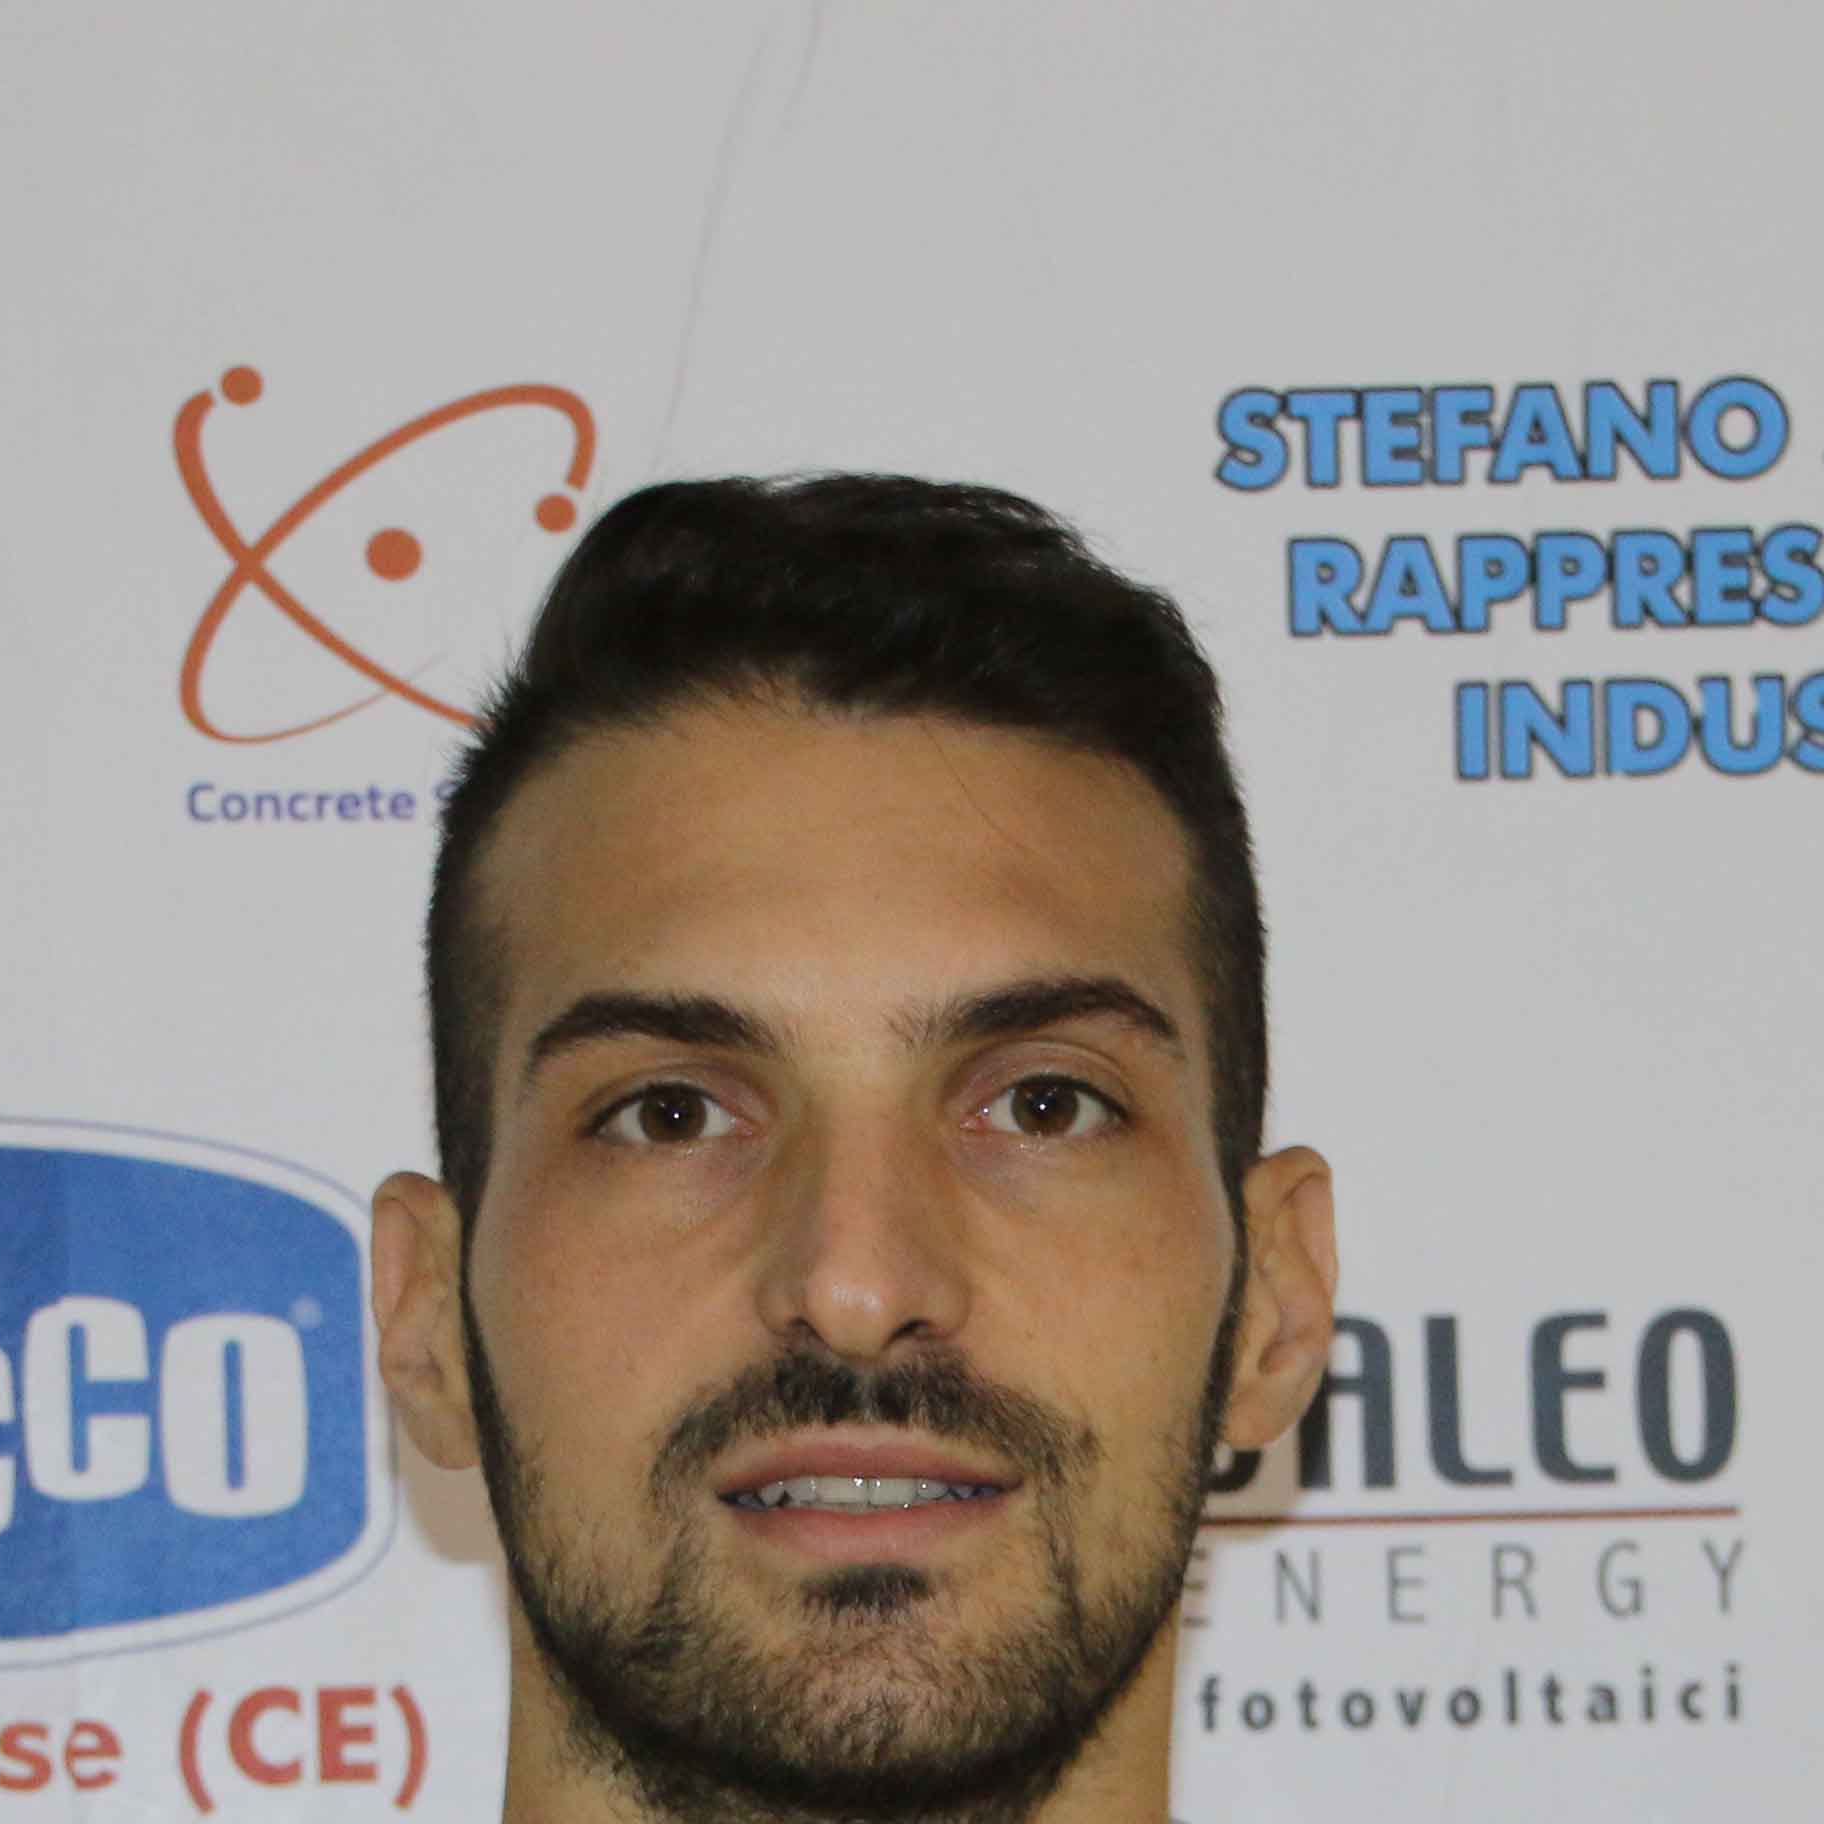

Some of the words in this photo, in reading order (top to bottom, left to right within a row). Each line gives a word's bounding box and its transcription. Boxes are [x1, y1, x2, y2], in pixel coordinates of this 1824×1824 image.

[1213, 377, 1790, 491] STEFANO
[186, 782, 416, 822] Concrete
[1204, 1305, 1738, 1492] ALEO
[178, 1685, 430, 1815] (CE)
[1200, 1667, 1742, 1732] fotovoltaici
